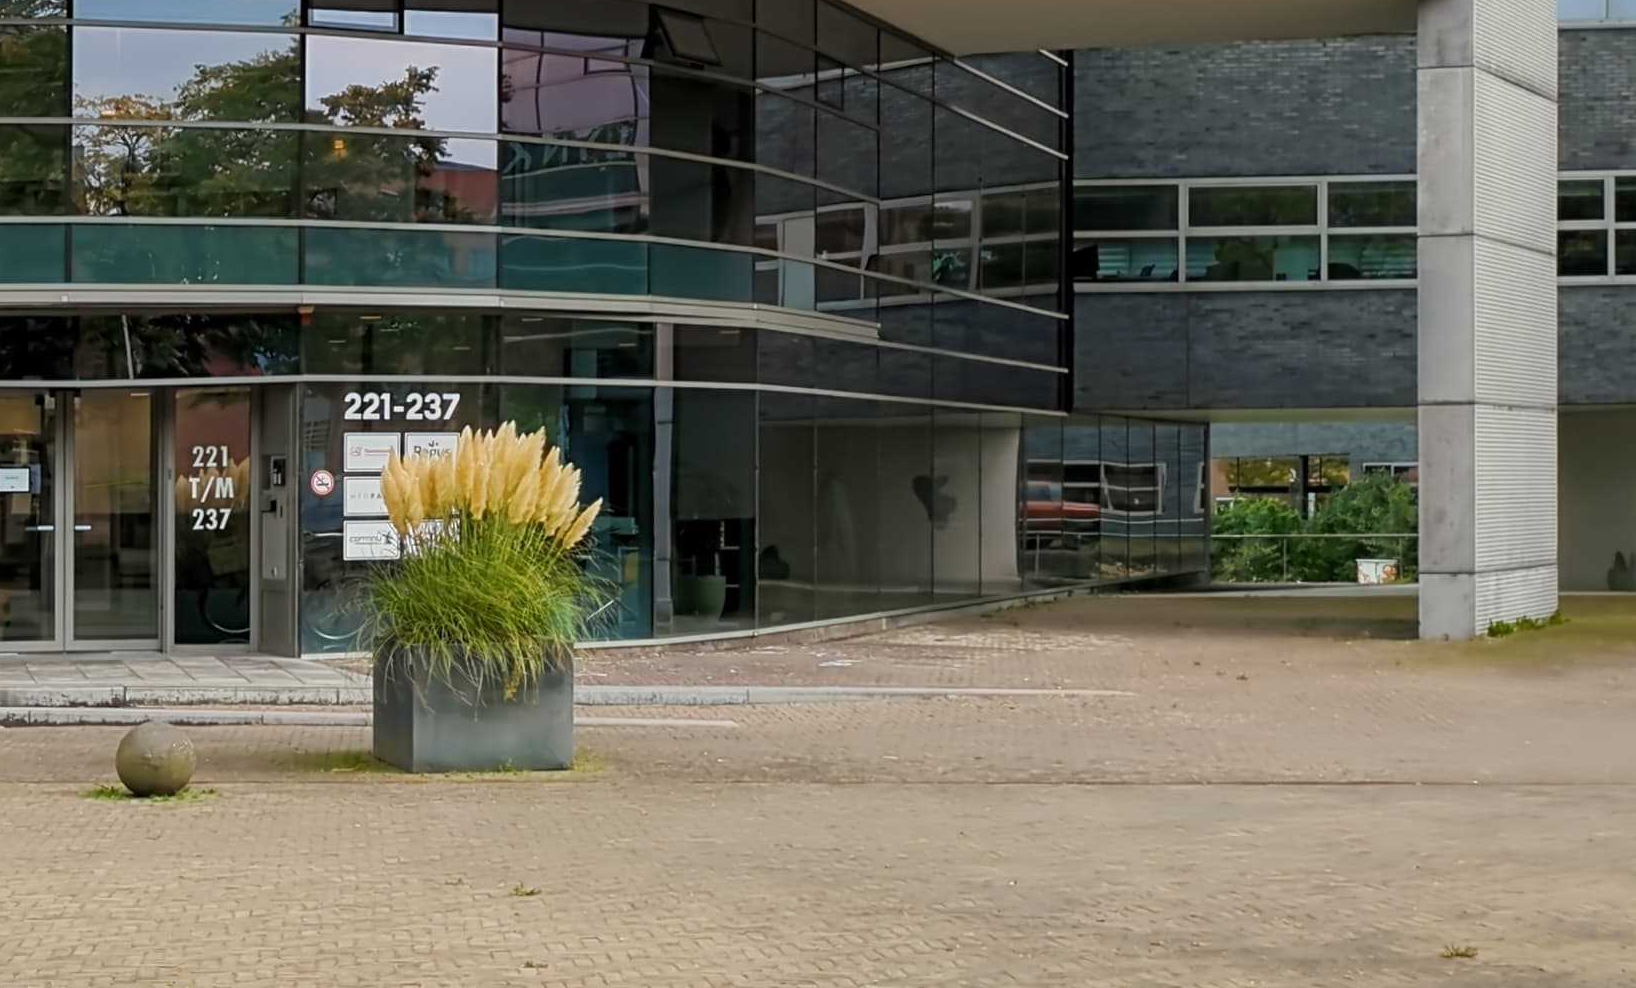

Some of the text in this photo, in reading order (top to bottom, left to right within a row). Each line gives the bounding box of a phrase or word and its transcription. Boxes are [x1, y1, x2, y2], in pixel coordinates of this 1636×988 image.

[344, 392, 461, 421] 221-237
[192, 445, 228, 468] 221
[188, 475, 235, 503] T/M
[192, 508, 232, 530] 237
